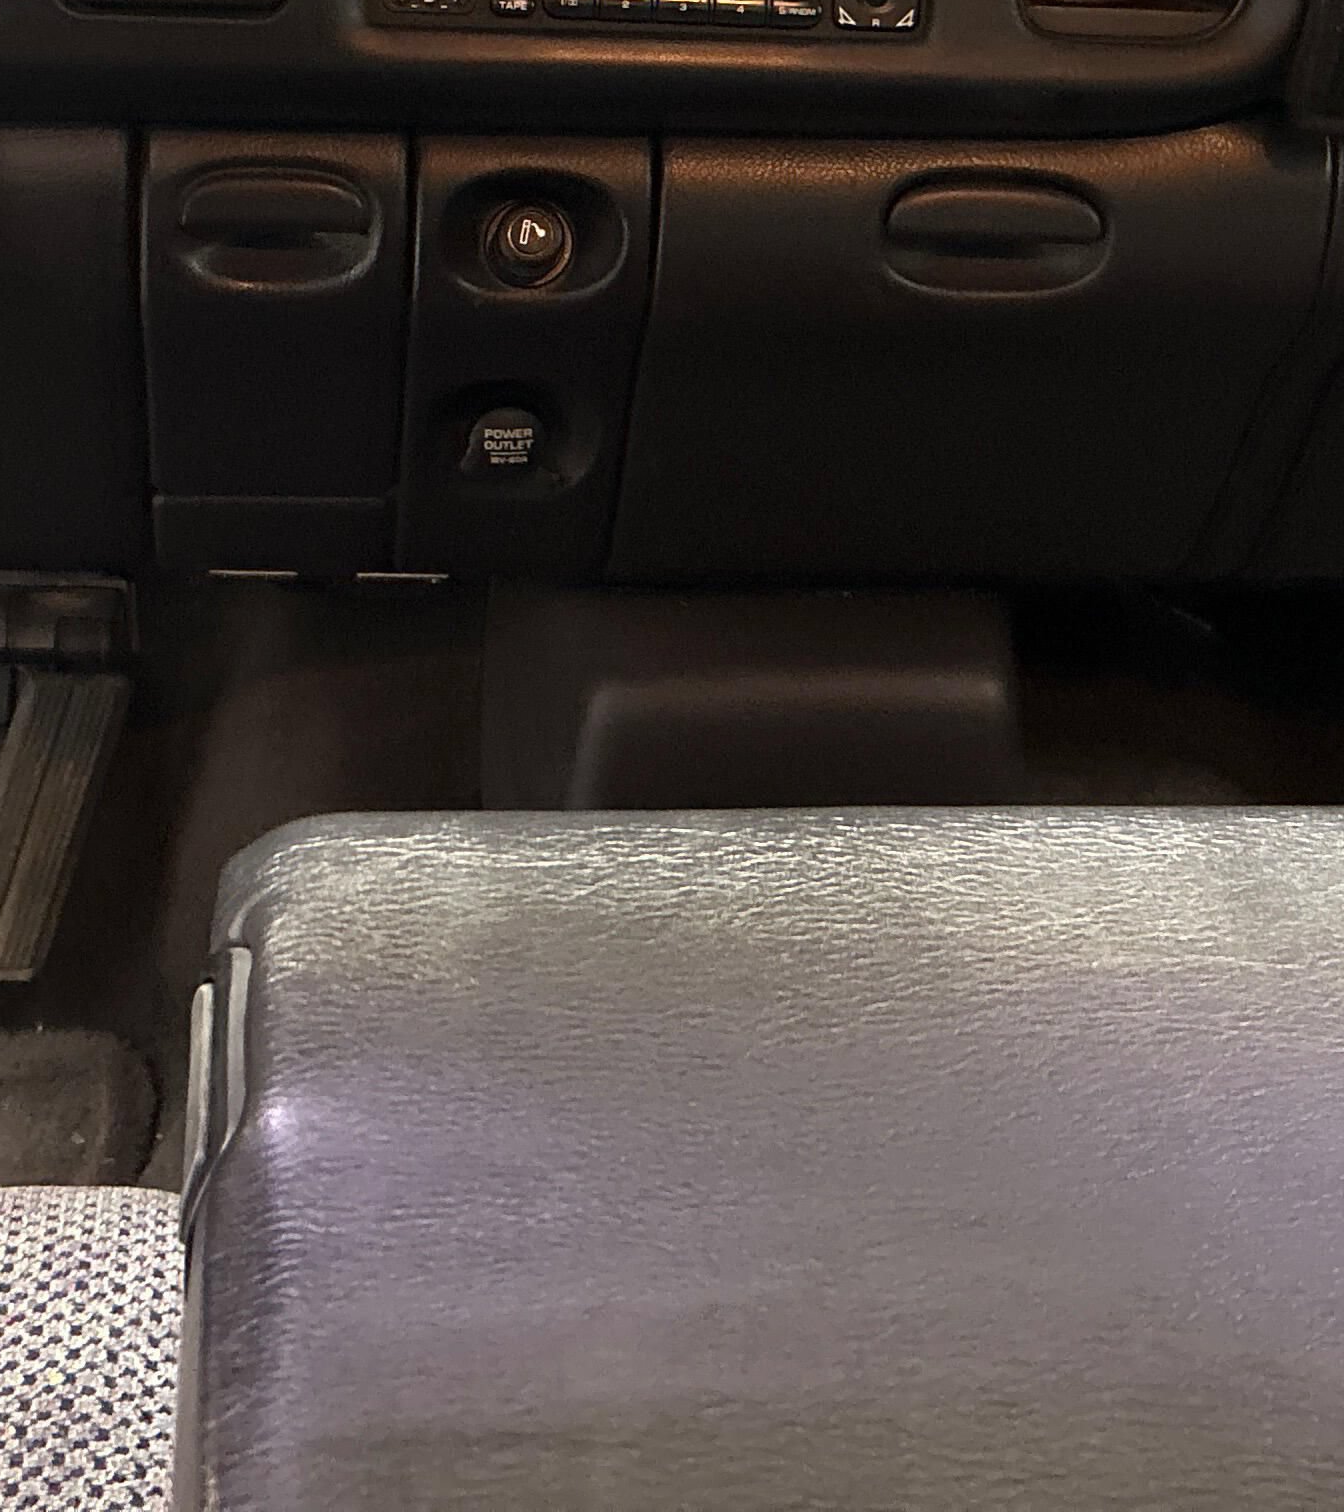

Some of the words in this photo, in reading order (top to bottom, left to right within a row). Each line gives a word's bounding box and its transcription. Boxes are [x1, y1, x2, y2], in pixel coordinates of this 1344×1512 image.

[499, 0, 528, 11] TAPE
[622, 0, 630, 9] 2
[679, 3, 688, 12] 3
[736, 4, 745, 14] 4
[484, 428, 533, 439] POWER
[484, 439, 534, 450] OUTLET
